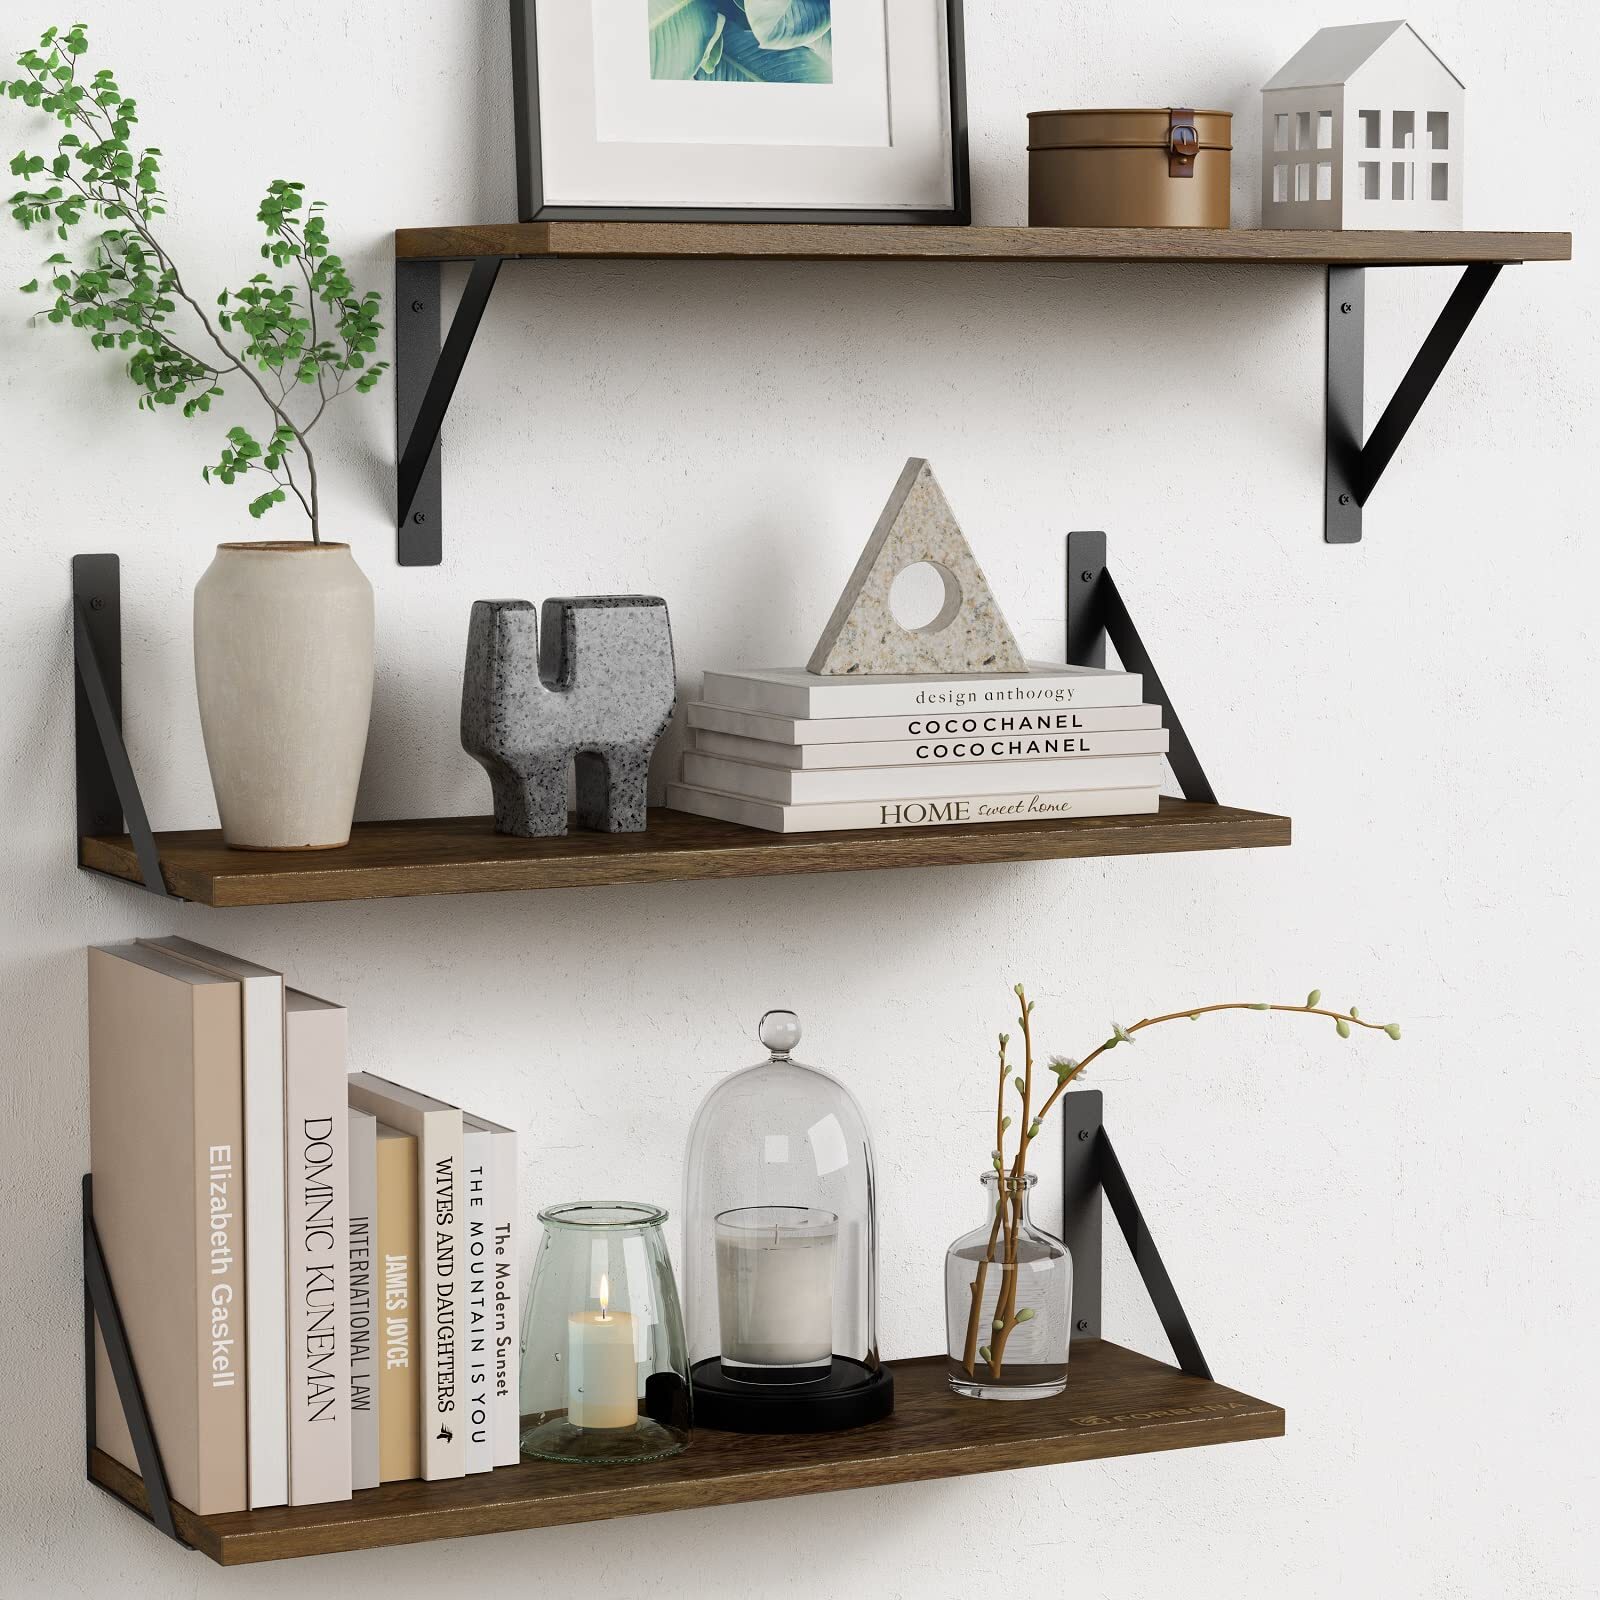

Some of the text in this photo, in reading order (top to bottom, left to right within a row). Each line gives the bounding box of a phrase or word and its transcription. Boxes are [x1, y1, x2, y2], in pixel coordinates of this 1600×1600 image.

[908, 714, 1083, 735] COCO CHANEL
[915, 690, 977, 707] design
[916, 738, 1090, 759] COCO CHANEL
[879, 794, 1072, 825] HOME sweet home
[208, 1144, 235, 1388] Elizabeth Gaskell
[303, 1116, 336, 1422] DOMINIC KUNEMAN
[349, 1216, 371, 1411] INTERNATIONAL LAW
[385, 1254, 409, 1370] JAMES JOYCE
[435, 1156, 455, 1413] WIVES AND DAUGHTERS
[469, 1166, 486, 1444] THE MOUNTAIN IS YOU
[495, 1222, 512, 1398] The Modern Sunset
[1112, 1402, 1248, 1422] FORBENA
